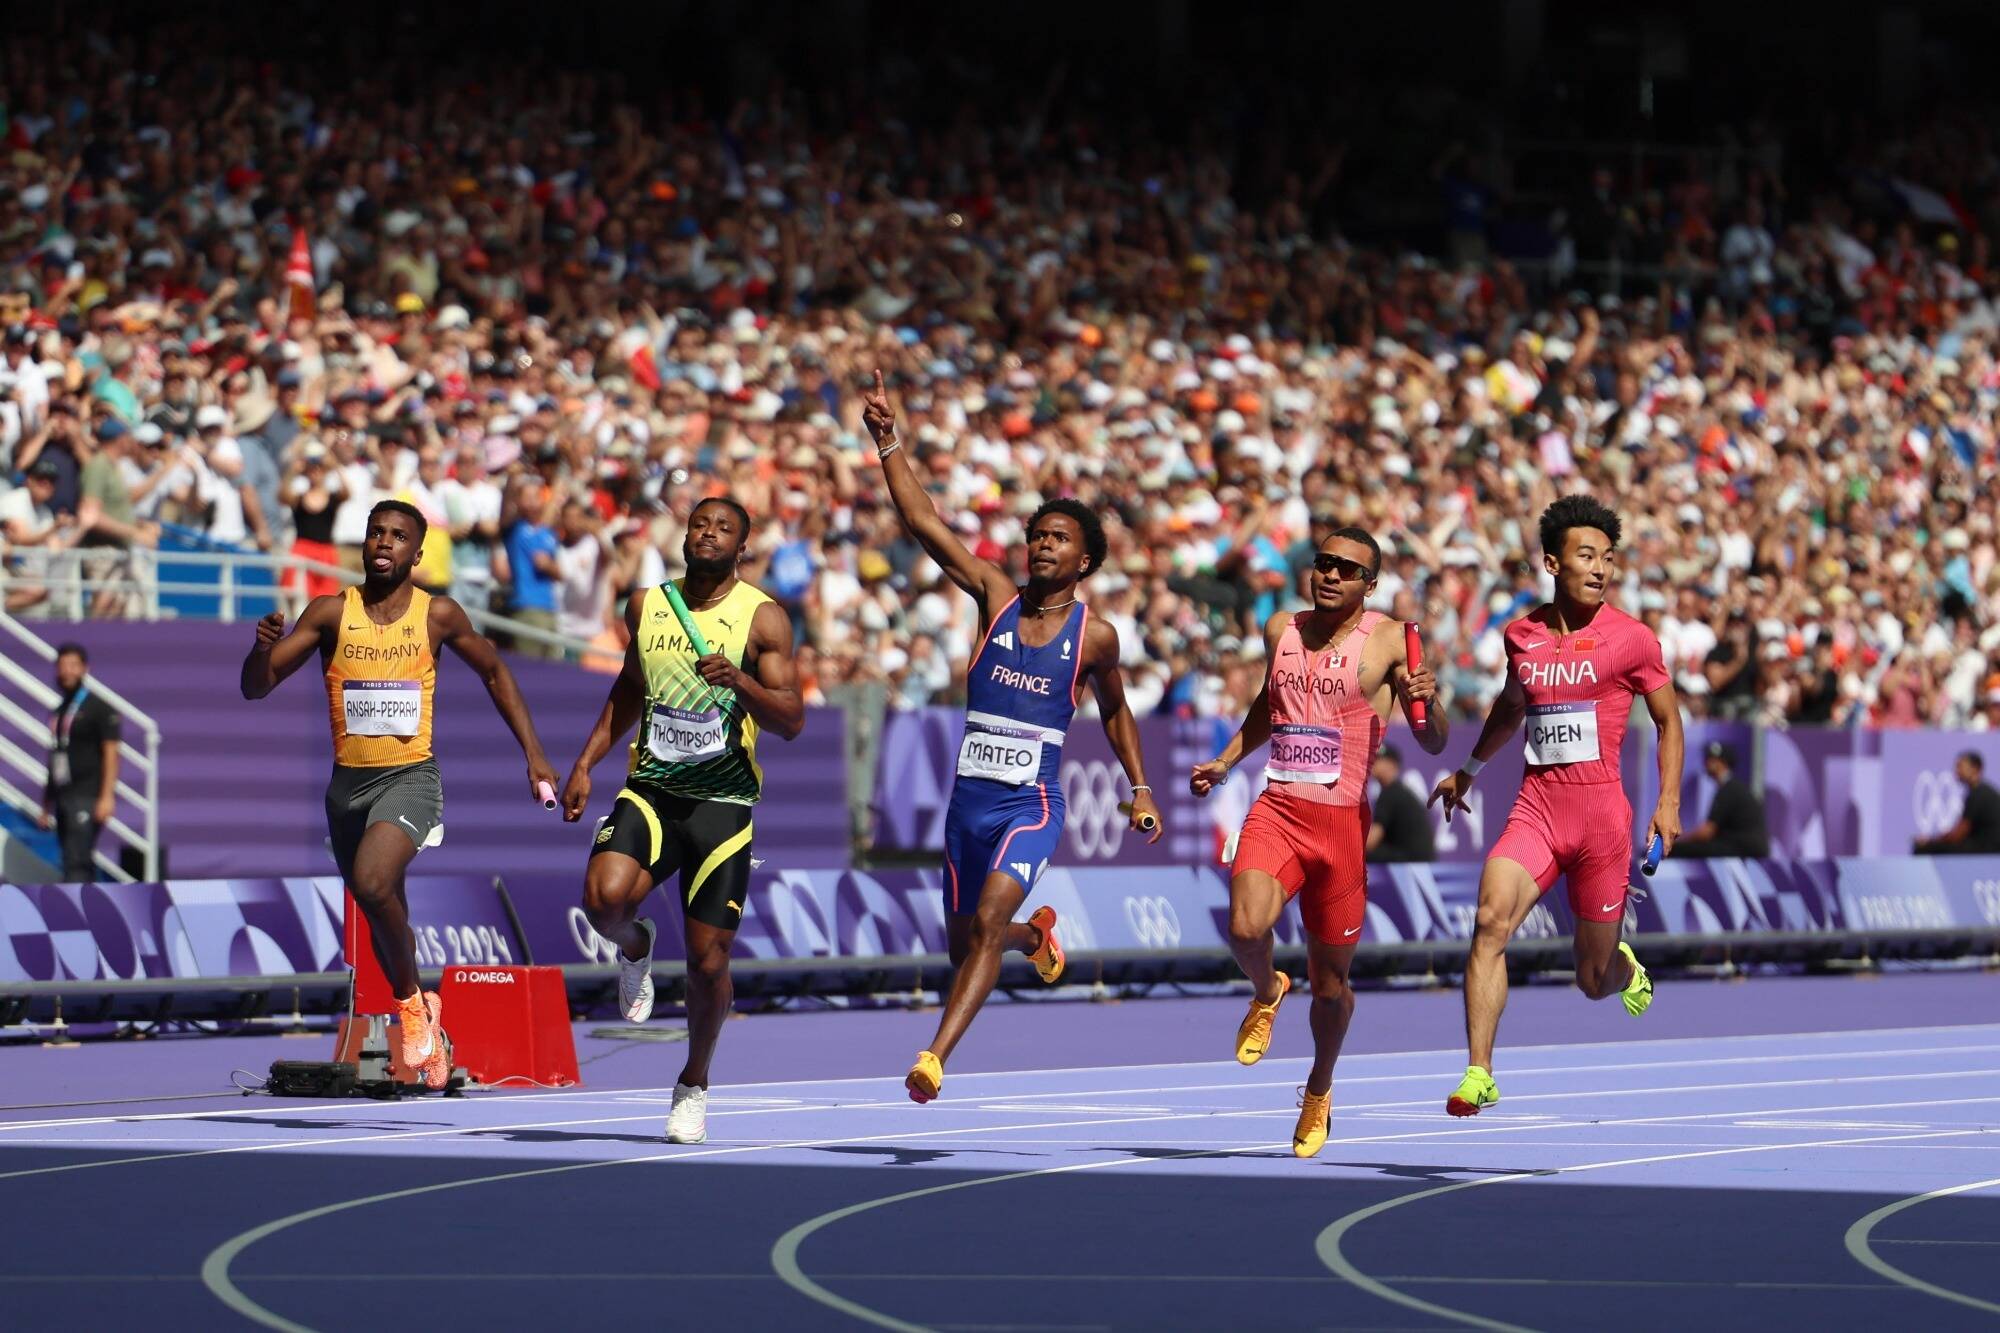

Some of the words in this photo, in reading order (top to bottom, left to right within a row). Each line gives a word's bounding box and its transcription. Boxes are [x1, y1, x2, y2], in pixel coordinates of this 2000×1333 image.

[343, 643, 422, 661] GERMANY
[990, 665, 1052, 695] FRANCE
[1275, 669, 1346, 697] CANADA
[1518, 660, 1598, 686] CHINA
[346, 700, 418, 718] ANSAH-PEPRAH
[653, 723, 722, 748] THOMPSON
[1534, 723, 1582, 745] CHEN
[967, 741, 1033, 767] MATEO
[445, 925, 513, 965] 2024
[469, 971, 515, 983] OMEGA
